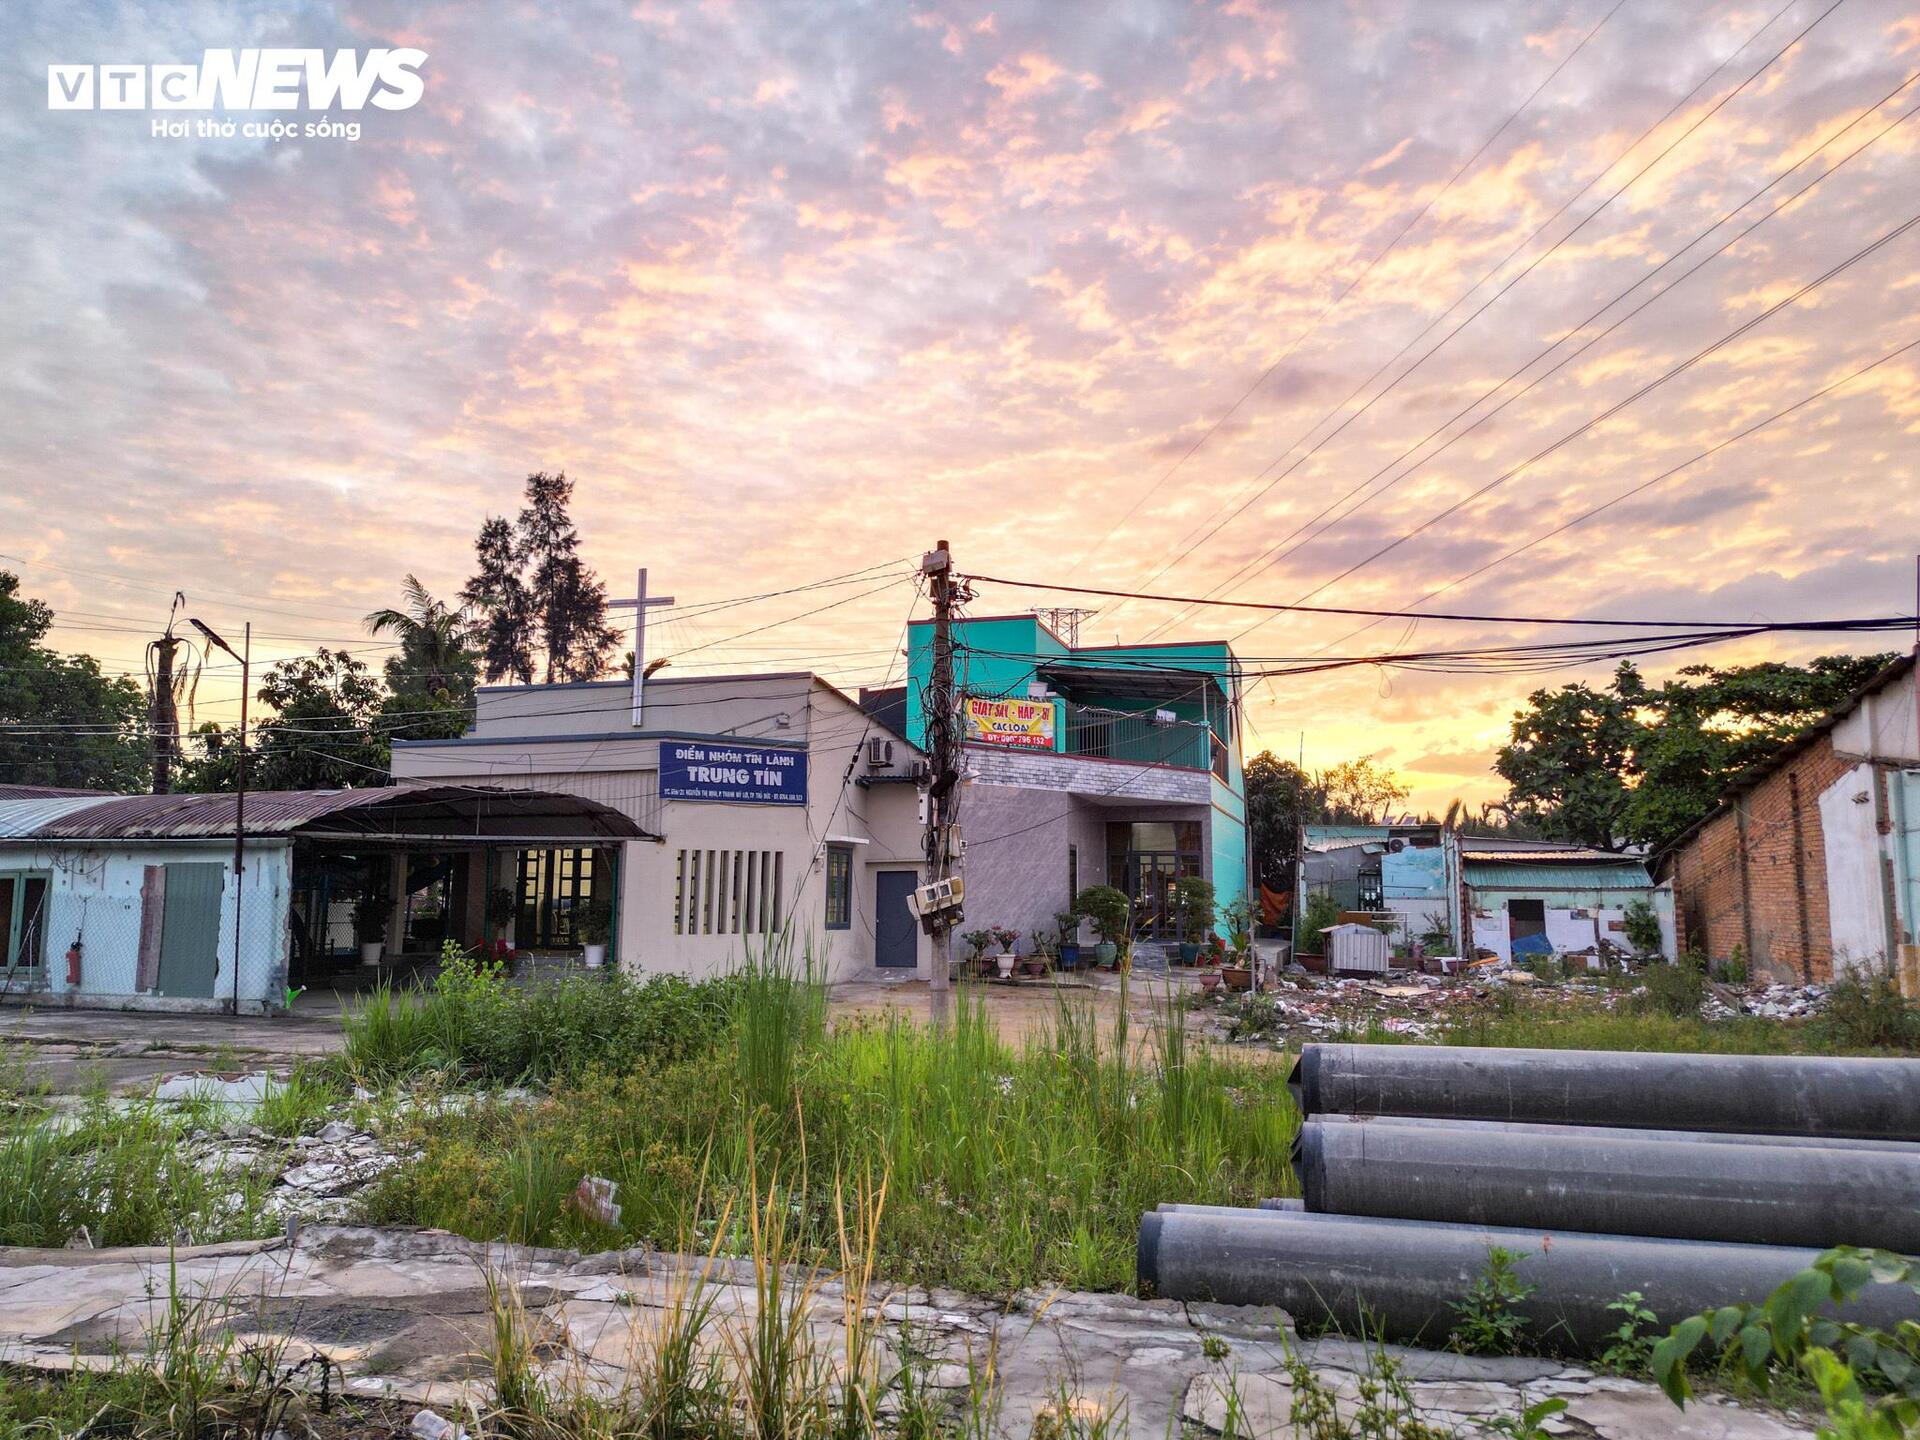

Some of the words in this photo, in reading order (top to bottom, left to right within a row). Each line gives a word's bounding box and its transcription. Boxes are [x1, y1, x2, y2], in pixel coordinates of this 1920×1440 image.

[676, 745, 704, 761] ĐIỂM
[709, 749, 742, 763] NHÓM
[744, 753, 762, 765] TIN
[766, 753, 795, 767] LÀNH
[687, 766, 750, 785] TRUNG
[754, 768, 783, 787] TÍN
